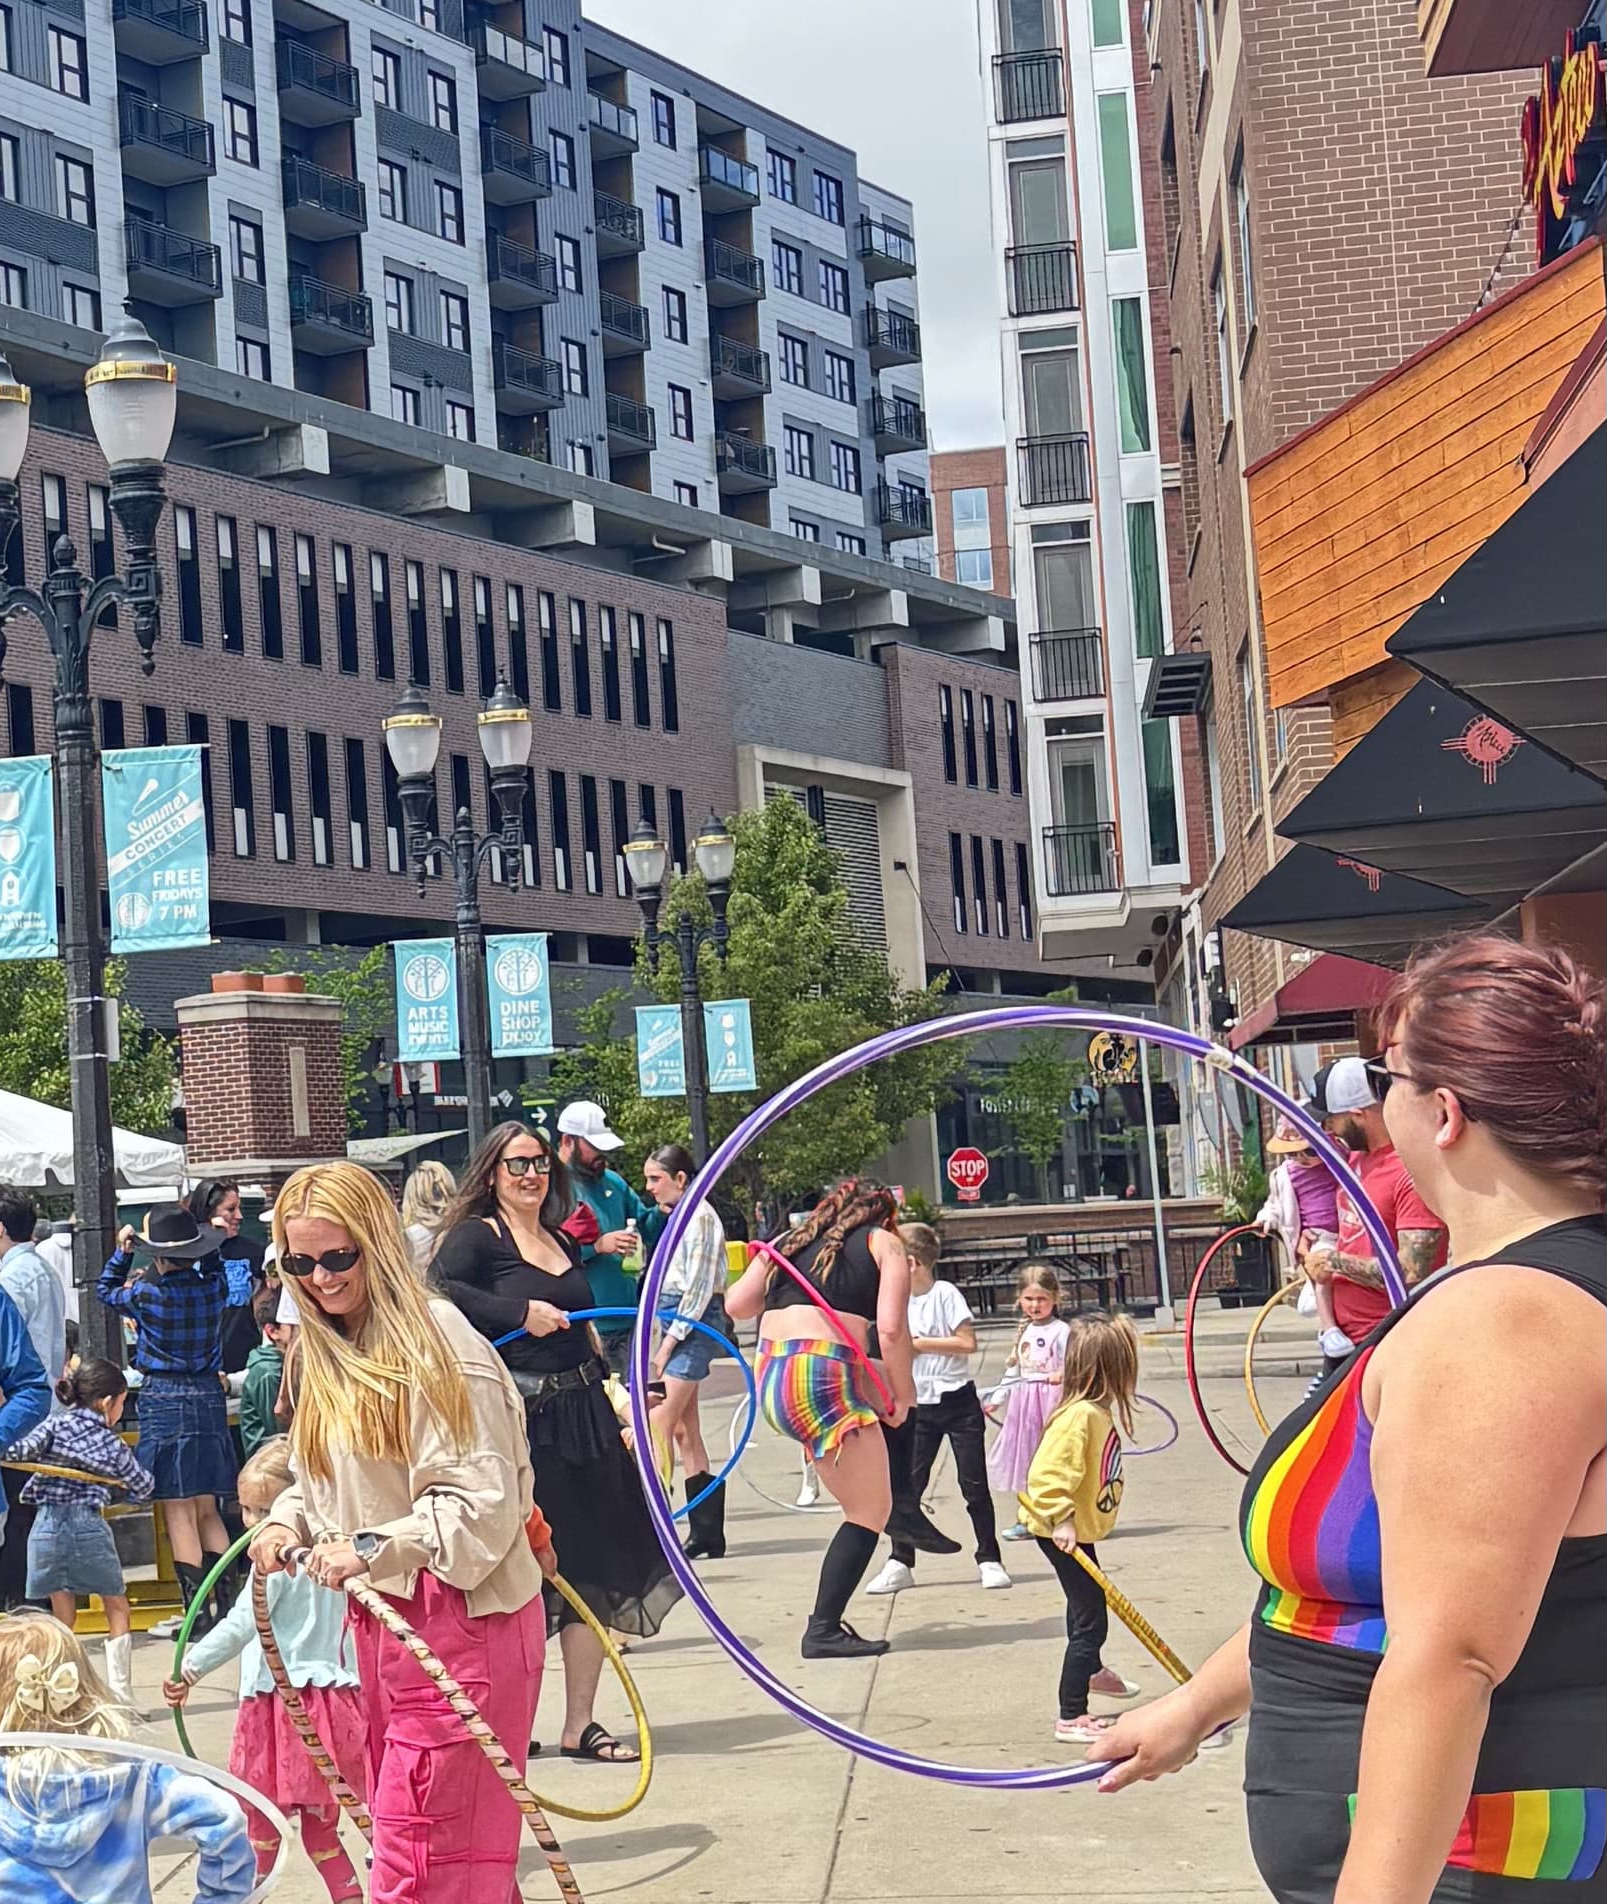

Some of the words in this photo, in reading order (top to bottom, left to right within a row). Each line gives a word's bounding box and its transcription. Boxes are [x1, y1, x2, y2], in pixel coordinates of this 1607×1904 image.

[127, 789, 190, 841] Summer
[125, 813, 188, 861] CONCERT
[153, 868, 202, 887] FREE
[160, 906, 168, 921] 7
[173, 904, 198, 920] PM
[408, 1006, 449, 1020] ARTS
[500, 1000, 540, 1015] DINE
[408, 1020, 449, 1034] MUSIC
[501, 1015, 541, 1031] SHOP
[951, 1159, 986, 1177] STOP
